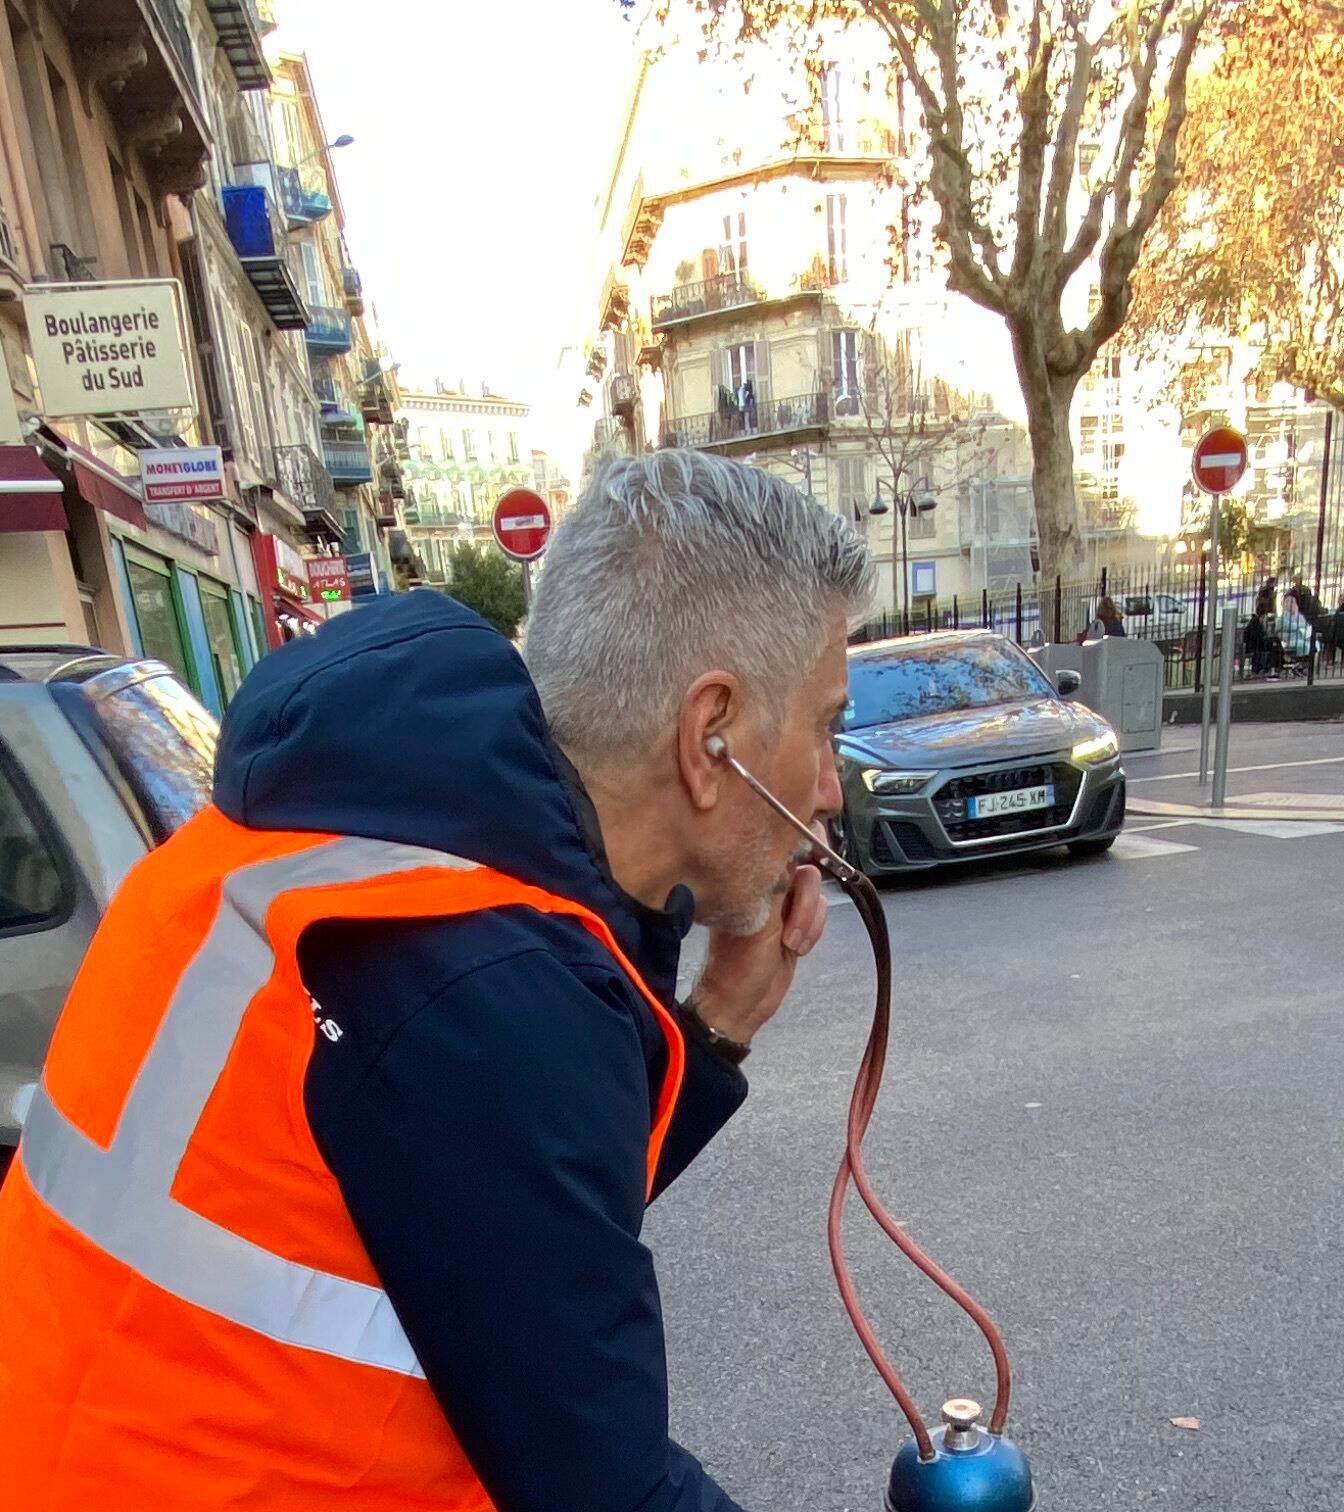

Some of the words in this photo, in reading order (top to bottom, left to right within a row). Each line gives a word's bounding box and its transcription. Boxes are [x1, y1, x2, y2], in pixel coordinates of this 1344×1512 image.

[44, 306, 159, 337] Boulangerie
[62, 335, 156, 364] Pâtisserie
[82, 368, 105, 391] du
[108, 364, 144, 388] Sud
